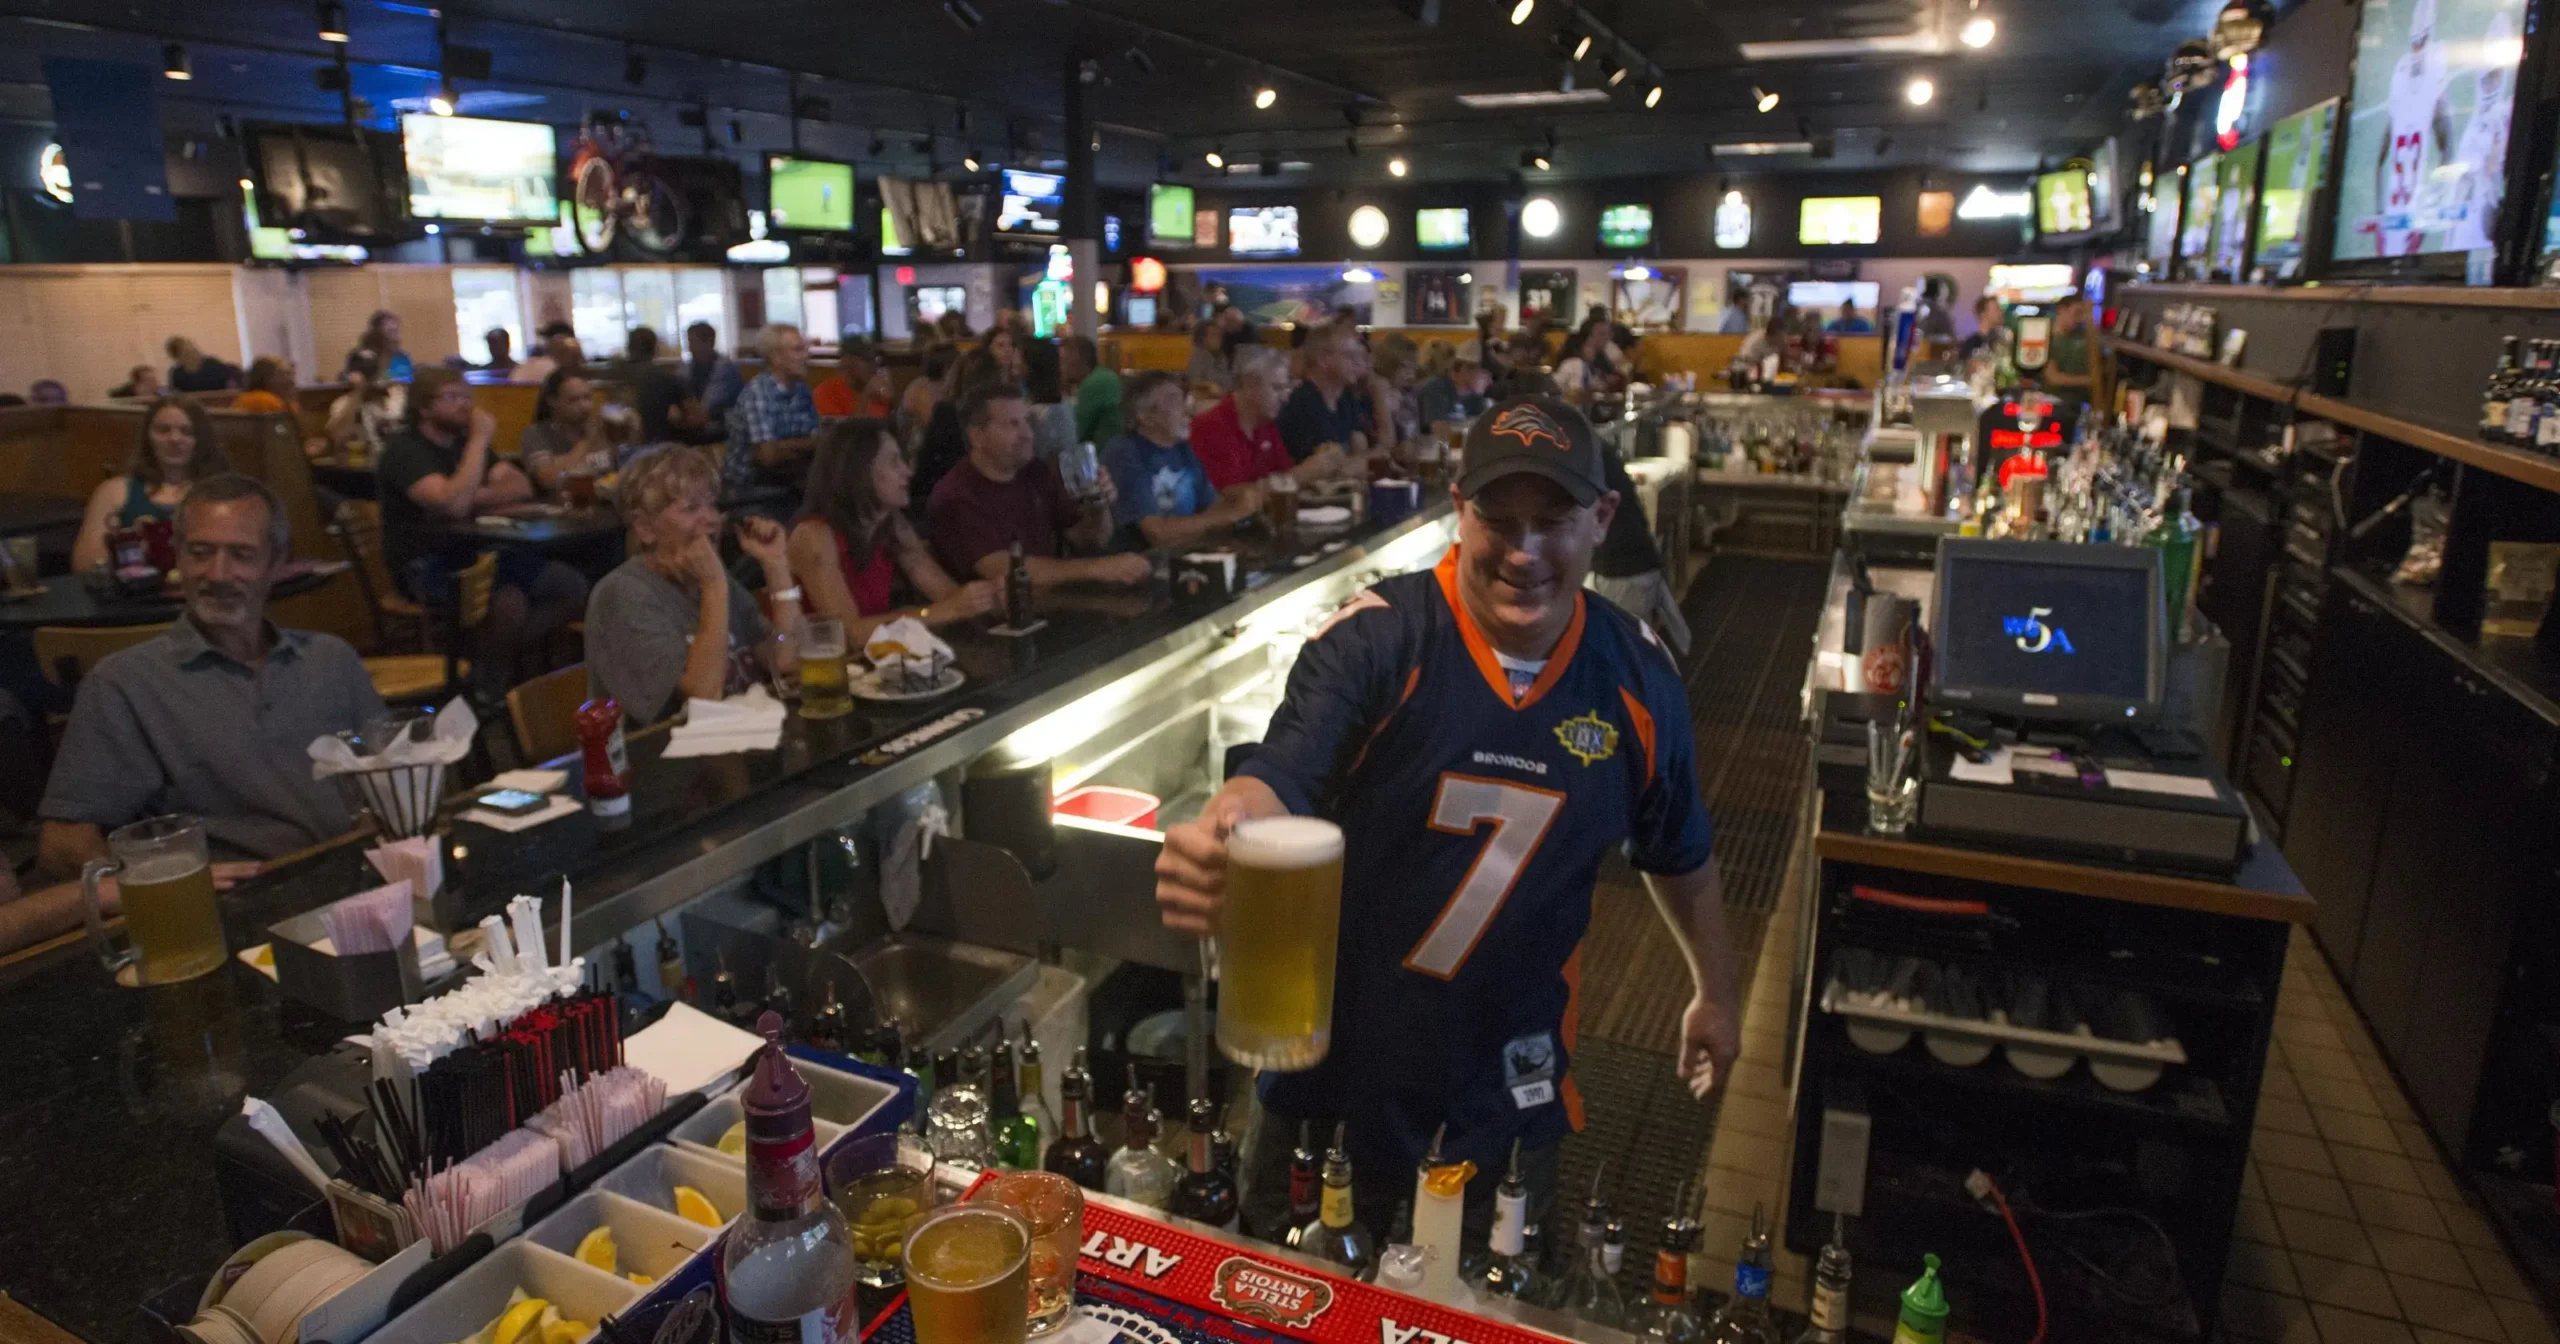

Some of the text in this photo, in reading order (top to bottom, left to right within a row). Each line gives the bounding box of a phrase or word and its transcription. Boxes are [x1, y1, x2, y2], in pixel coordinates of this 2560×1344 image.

[1402, 771, 1568, 982] 7
[1234, 1280, 1303, 1311] STELLA
[1237, 1269, 1311, 1299] ARTOIS
